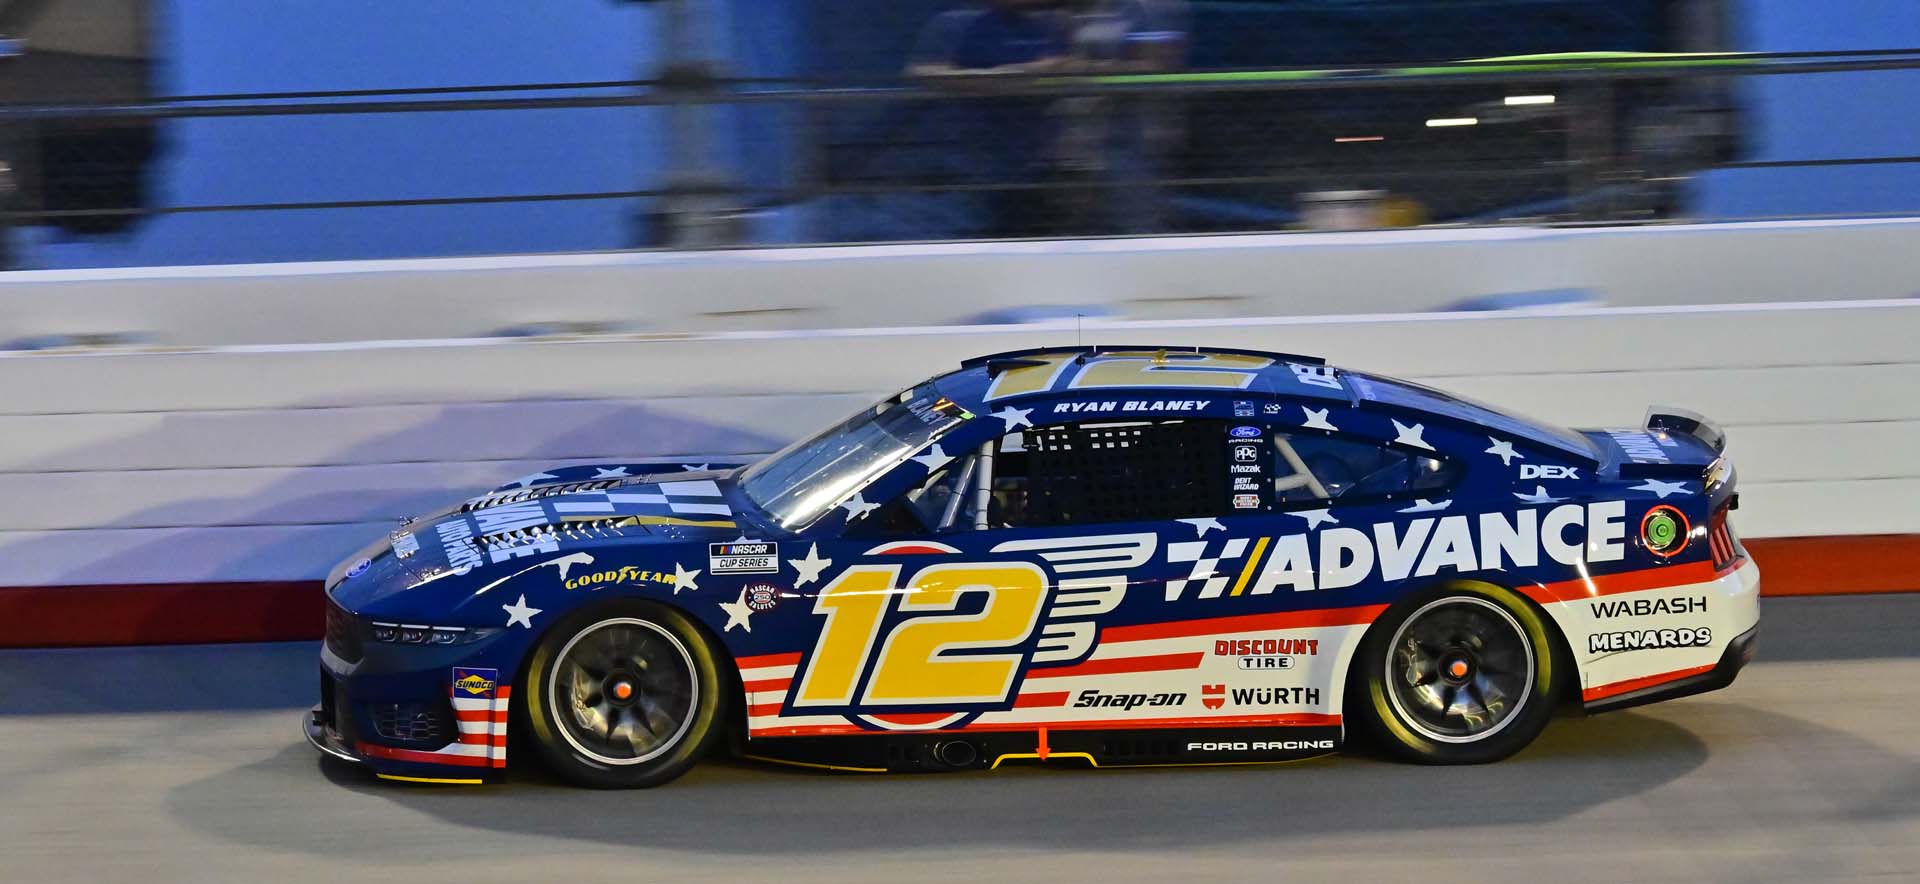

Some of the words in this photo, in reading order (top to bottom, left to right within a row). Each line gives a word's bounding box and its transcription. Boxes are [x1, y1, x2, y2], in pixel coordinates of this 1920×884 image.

[983, 351, 1275, 402] 12
[1054, 401, 1117, 413] RYAN
[1123, 400, 1210, 412] BLANEY
[1231, 465, 1260, 473] Mazak
[1520, 464, 1580, 479] DEX
[731, 545, 768, 555] NASCAR
[1250, 501, 1626, 596] ADVANCE
[720, 559, 737, 568] CUP
[738, 558, 768, 567] SERIES
[565, 567, 675, 590] GOODYEAR
[750, 584, 775, 594] NASCAR
[749, 600, 776, 610] SALUTES
[1591, 596, 1707, 619] WABASH
[793, 561, 1049, 707] 12
[1589, 627, 1712, 653] MENARDS
[1214, 639, 1318, 656] DISCOUNT
[1243, 658, 1289, 668] TIRE
[456, 679, 495, 690] SUNOCO
[1073, 689, 1187, 711] Snap-on
[1188, 742, 1248, 752] FORD
[1252, 740, 1334, 750] RACING
